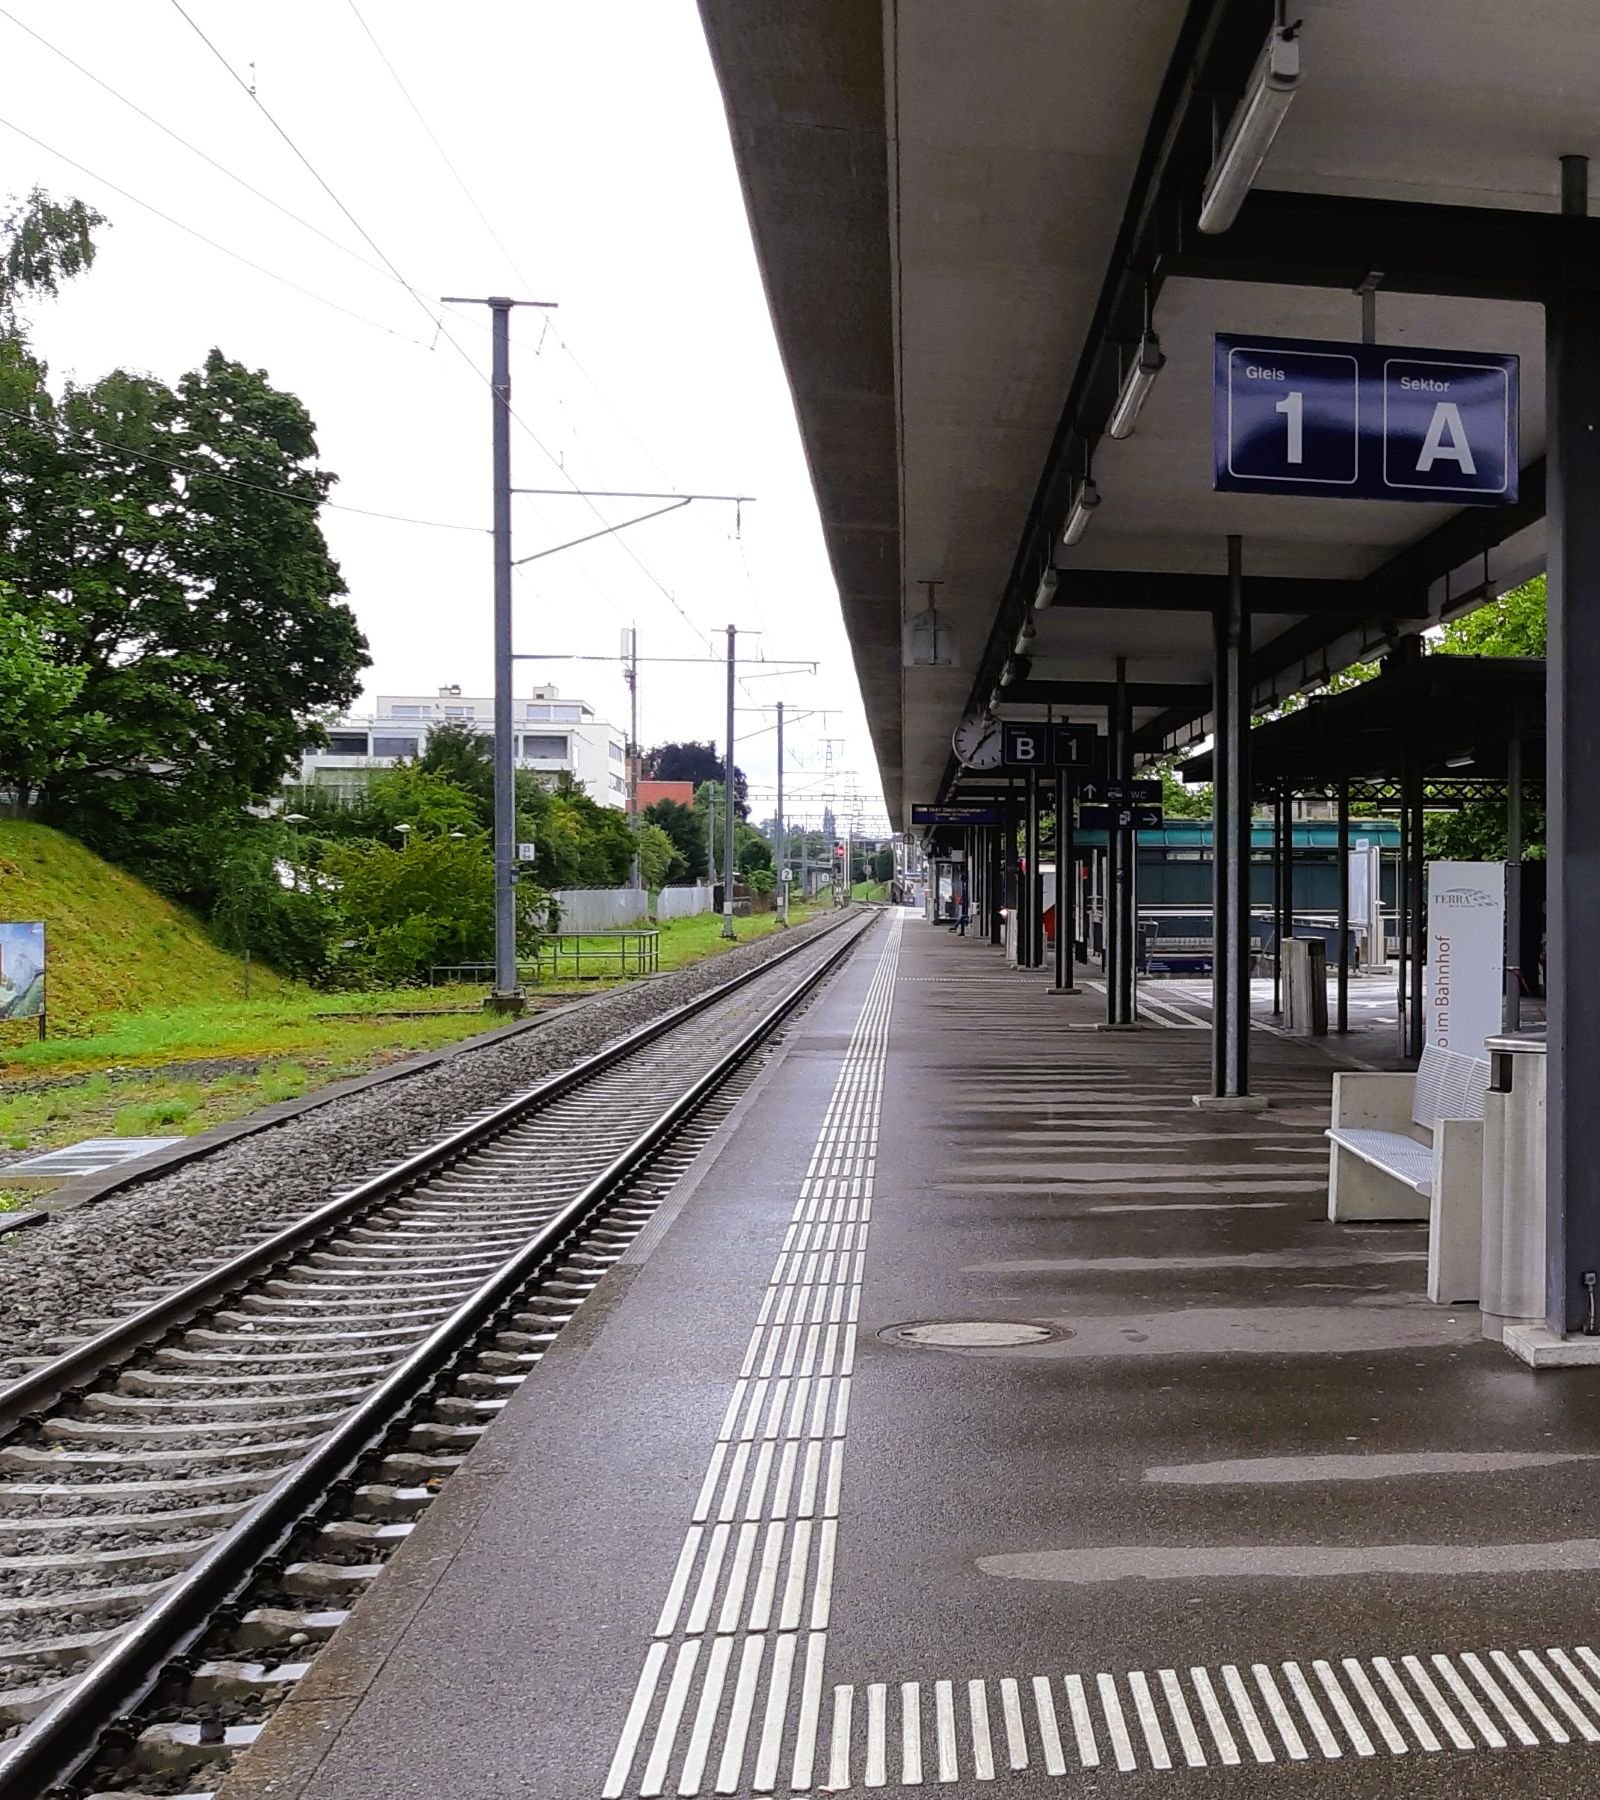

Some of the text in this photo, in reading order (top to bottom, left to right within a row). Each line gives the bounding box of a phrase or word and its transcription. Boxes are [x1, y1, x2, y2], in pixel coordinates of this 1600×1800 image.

[1245, 366, 1286, 381] Gleis
[1400, 376, 1450, 393] Sektor
[1275, 391, 1303, 464] 1
[1415, 402, 1477, 475] A
[1016, 737, 1035, 760] B
[1067, 739, 1077, 761] 1
[783, 870, 790, 880] 2
[1433, 894, 1471, 905] TERRA
[1434, 934, 1450, 1007] Bahnhof
[1434, 1012, 1449, 1032] im
